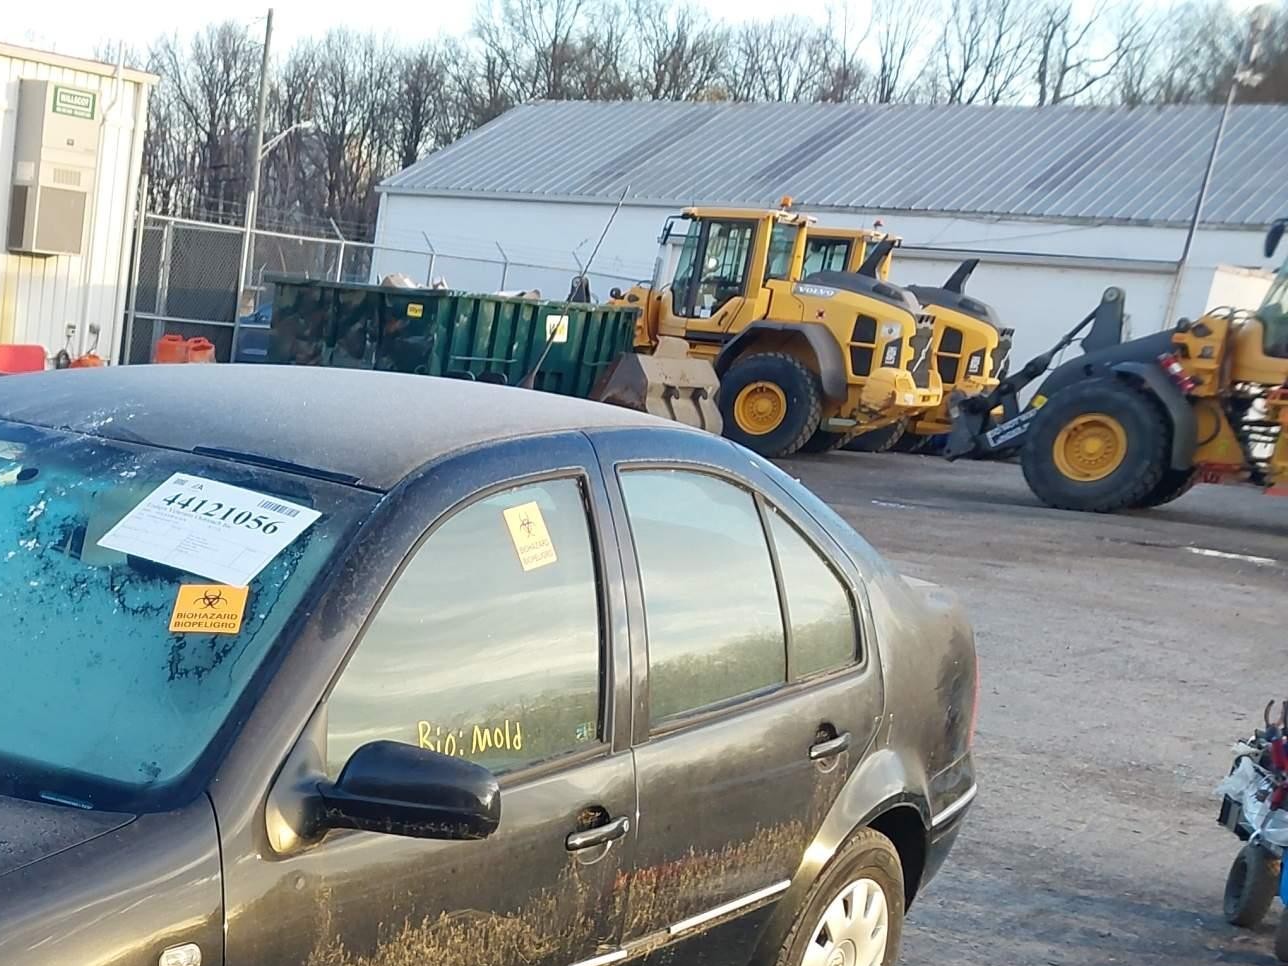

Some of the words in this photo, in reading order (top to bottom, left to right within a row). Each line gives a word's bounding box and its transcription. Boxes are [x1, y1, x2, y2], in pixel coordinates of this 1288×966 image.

[798, 286, 835, 297] VOLVO
[162, 492, 284, 536] 44121056
[176, 612, 239, 620] BIOHAZARD
[173, 621, 237, 629] BIOPELIGRO
